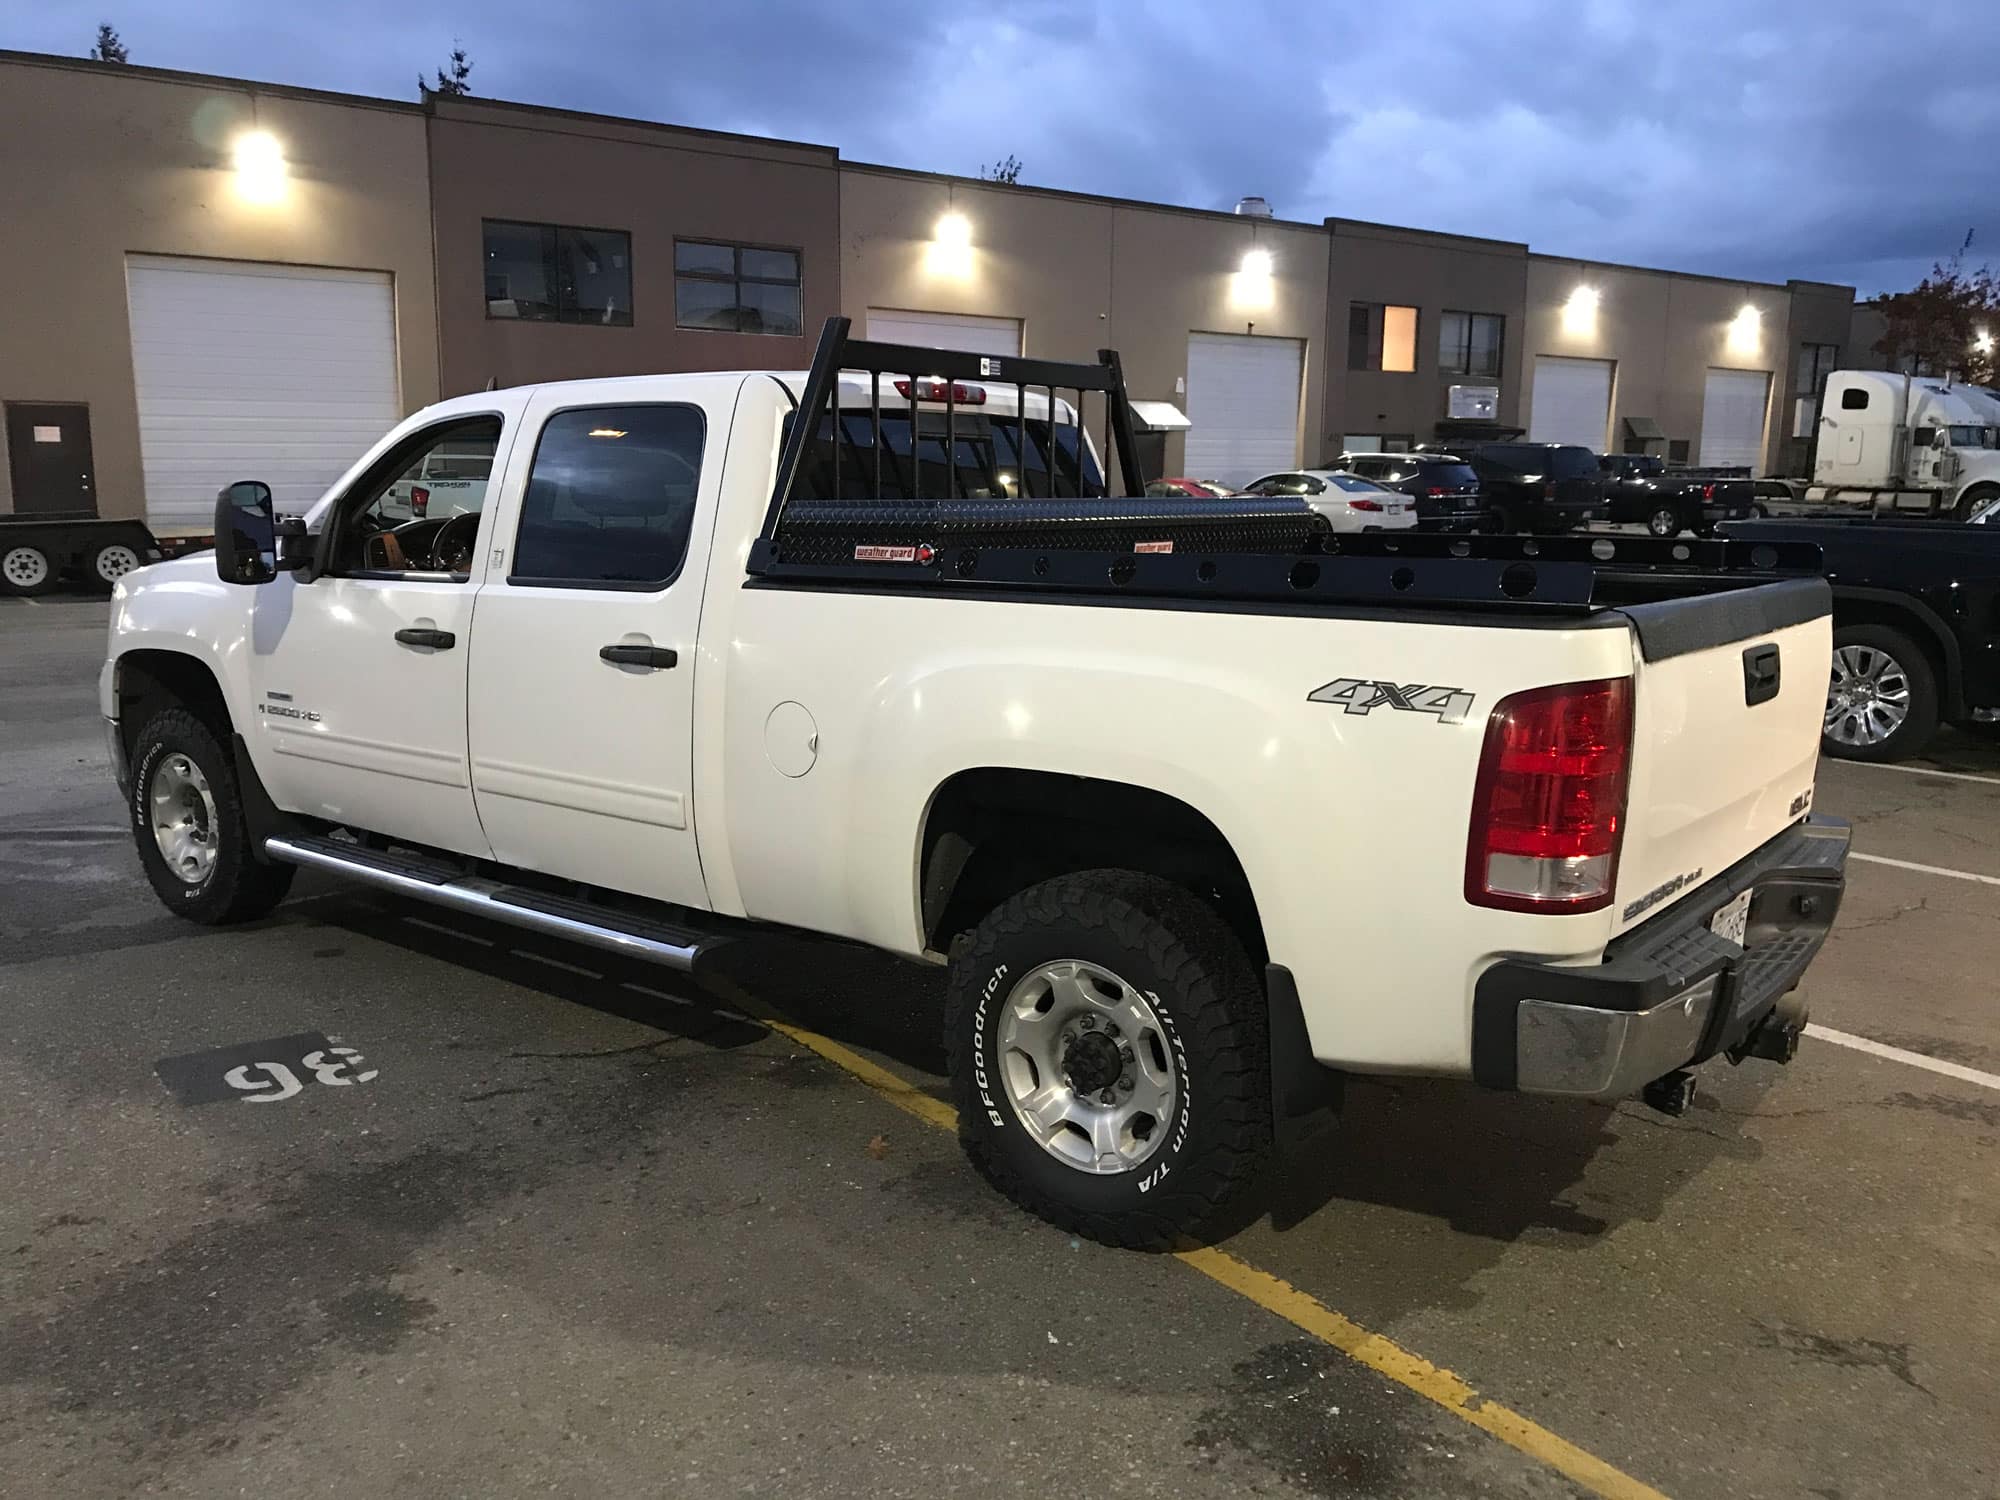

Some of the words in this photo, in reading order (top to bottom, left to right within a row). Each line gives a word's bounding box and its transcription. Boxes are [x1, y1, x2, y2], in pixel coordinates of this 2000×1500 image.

[857, 546, 888, 557] weather
[890, 548, 913, 558] guard
[974, 963, 1008, 1127] BFGoodrich
[1144, 990, 1190, 1152] All-Terrain
[224, 1048, 379, 1102] 36
[1138, 1162, 1170, 1193] T/A
